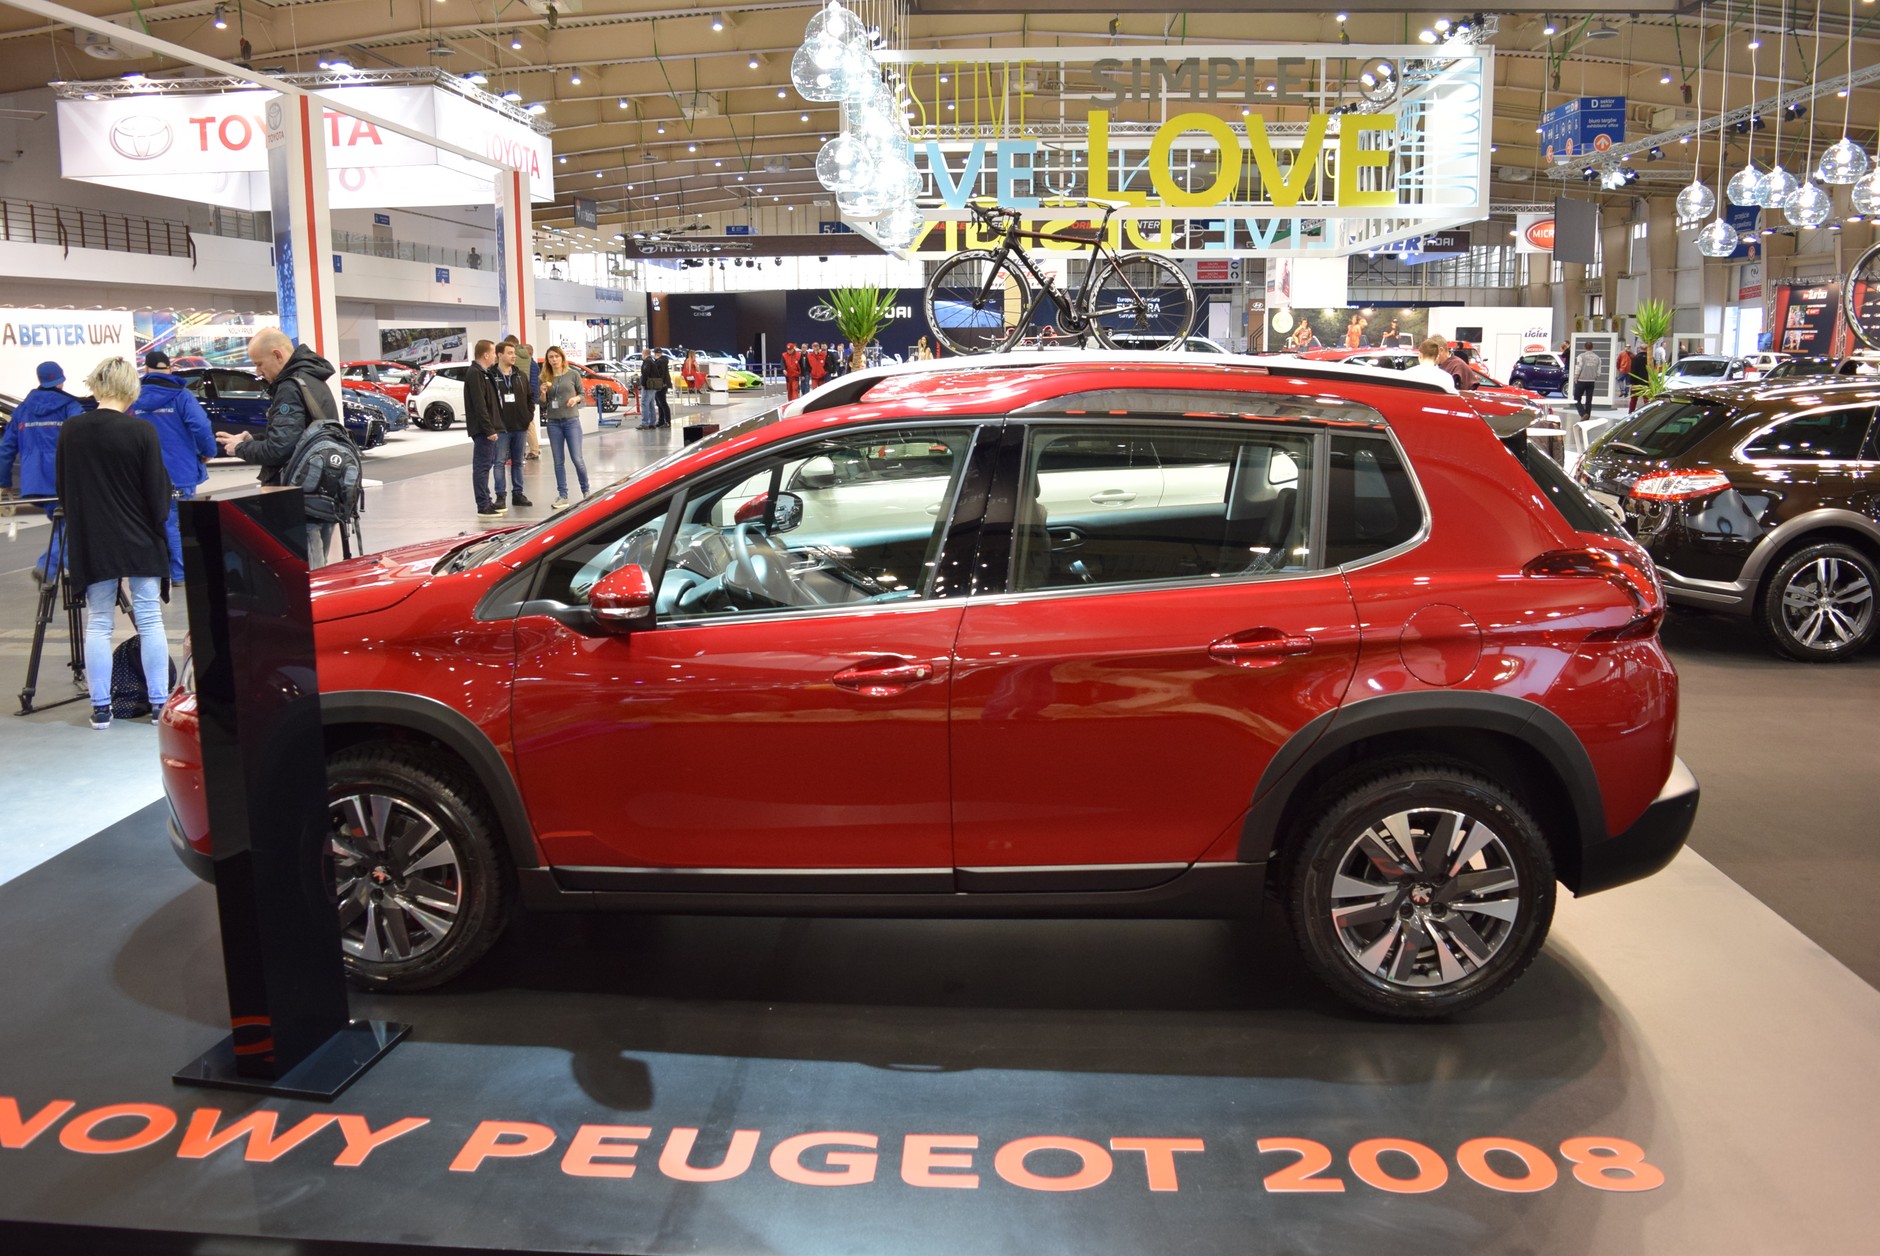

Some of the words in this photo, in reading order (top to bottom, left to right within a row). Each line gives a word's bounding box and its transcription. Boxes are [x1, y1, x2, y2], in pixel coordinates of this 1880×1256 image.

[907, 60, 1038, 143] SITIVE
[1090, 57, 1305, 107] SIMPLE
[189, 108, 383, 152] TOTA
[1087, 110, 1397, 208] LOVE
[1123, 221, 1161, 230] CNTER
[1532, 229, 1555, 238] MICR
[2, 322, 18, 346] A
[18, 323, 86, 346] BETTER
[88, 323, 123, 345] WAY
[448, 1119, 1206, 1194] PEUGEOT
[1256, 1136, 1667, 1196] 2008
